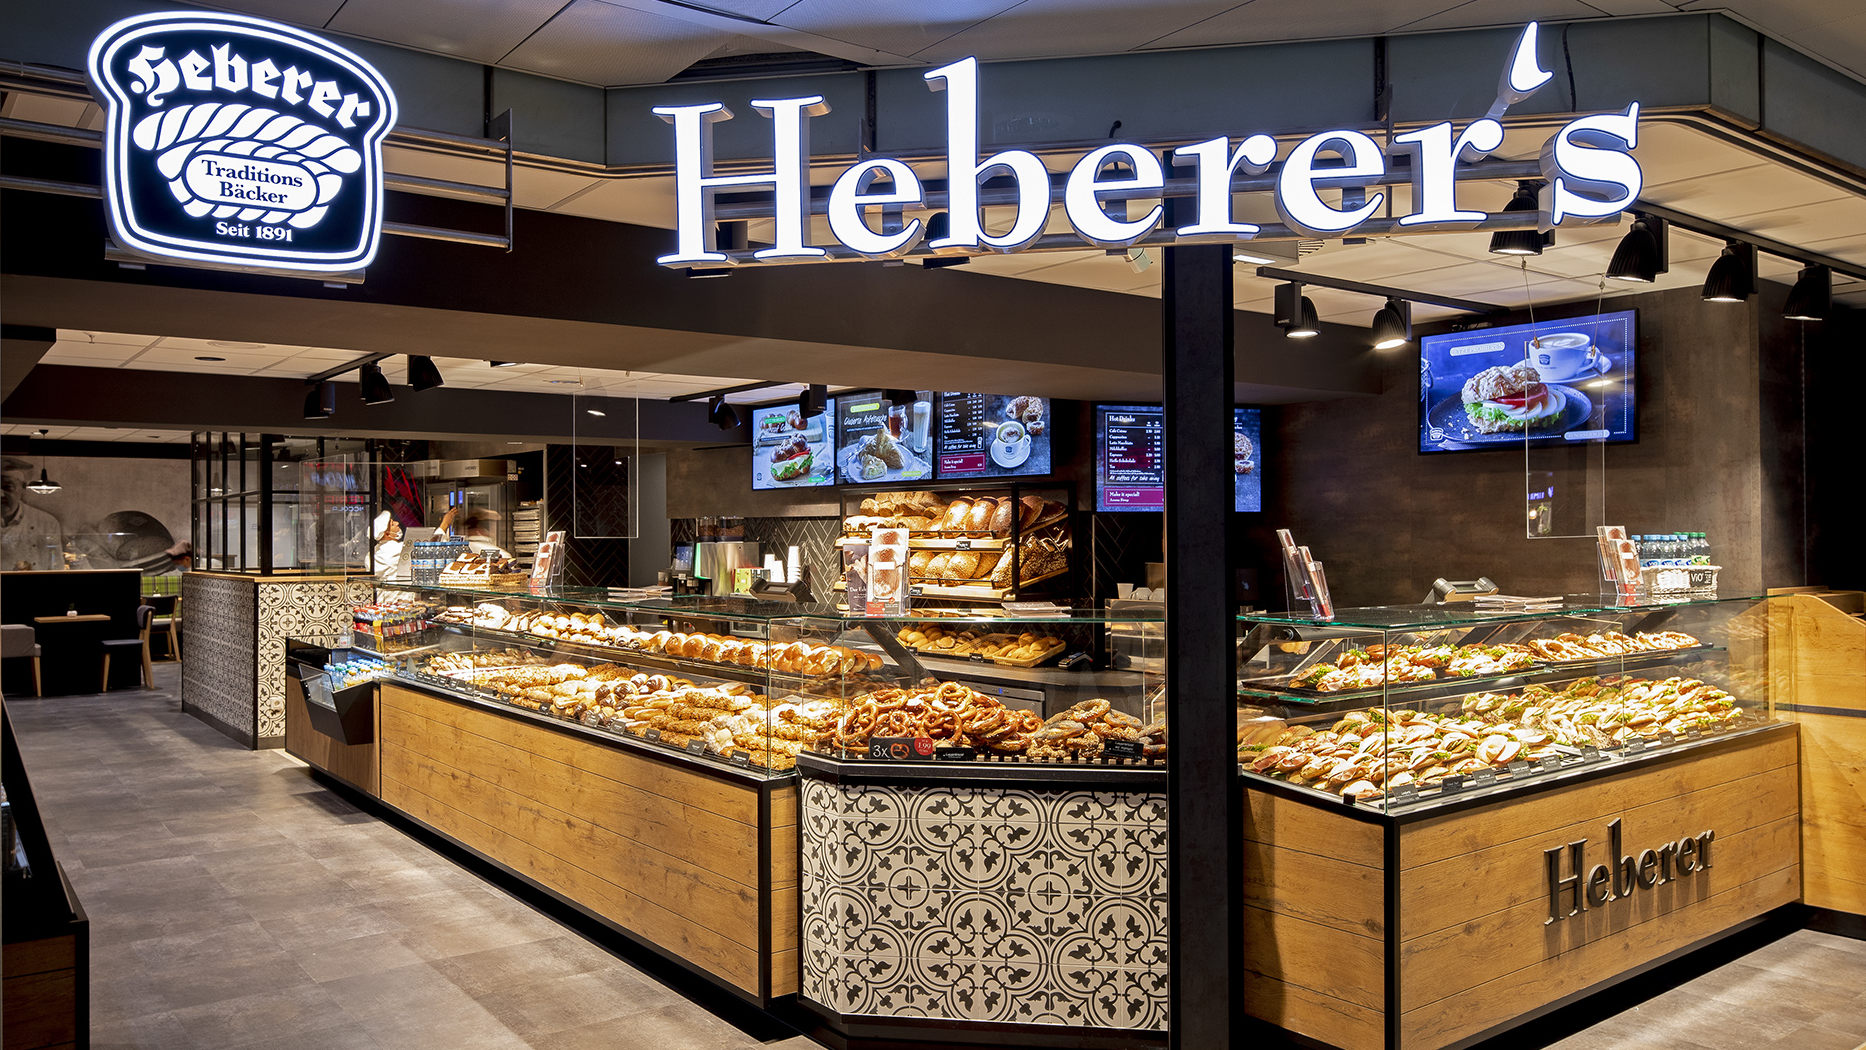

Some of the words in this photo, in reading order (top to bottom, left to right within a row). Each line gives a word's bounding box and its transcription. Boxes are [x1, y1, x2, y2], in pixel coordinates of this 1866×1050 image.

[128, 42, 370, 129] Heberer
[653, 20, 1643, 268] Heberer's
[201, 158, 304, 188] Traditions
[219, 181, 289, 205] Bäcker
[215, 221, 250, 238] Seit
[255, 225, 293, 242] 1891
[1119, 414, 1136, 423] Drinks
[1544, 817, 1715, 926] Heberer
